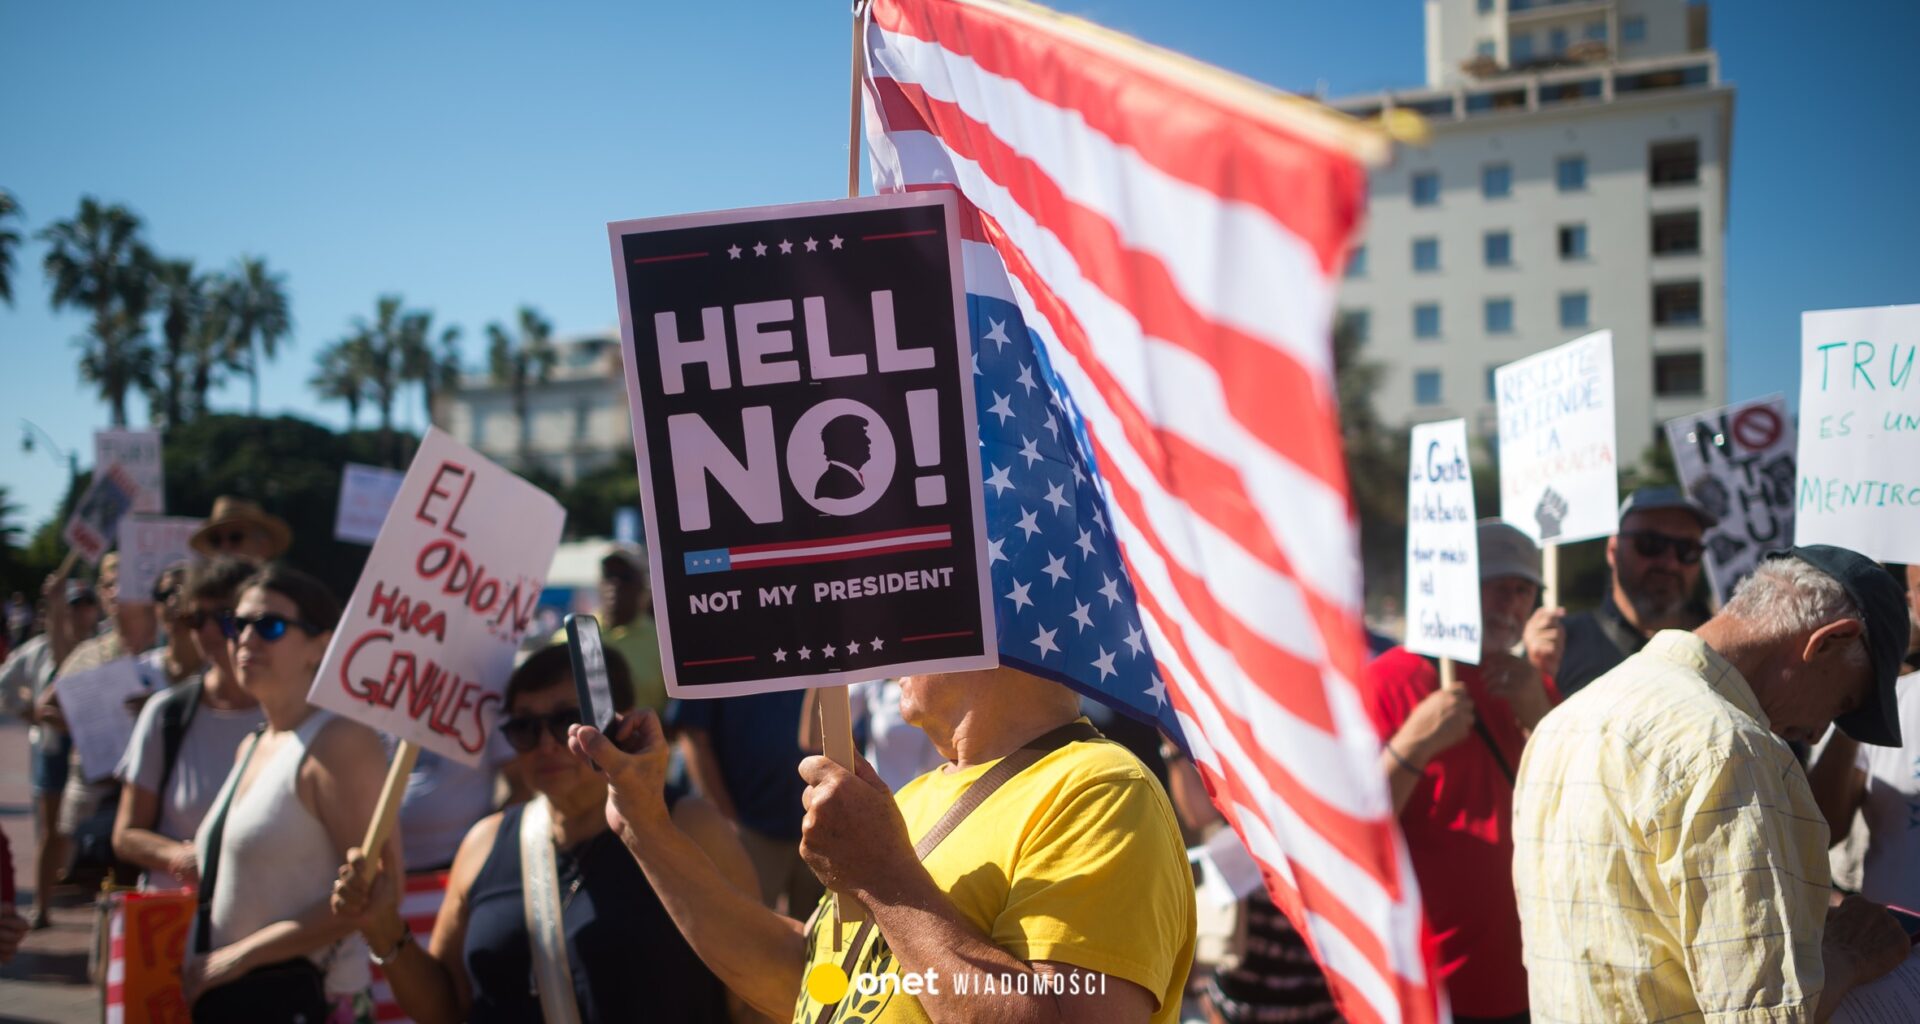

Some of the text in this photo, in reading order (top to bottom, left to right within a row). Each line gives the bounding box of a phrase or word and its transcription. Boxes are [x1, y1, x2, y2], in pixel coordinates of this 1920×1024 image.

[654, 290, 935, 395] HELL
[1817, 341, 1920, 391] TRU
[1536, 425, 1561, 457] LA
[1820, 411, 1854, 439] ES
[667, 388, 947, 532] NO!
[415, 460, 475, 538] EL
[415, 539, 501, 615] ODIO
[689, 567, 954, 614] NOT MY PRESIDENT
[367, 580, 447, 643] HARA
